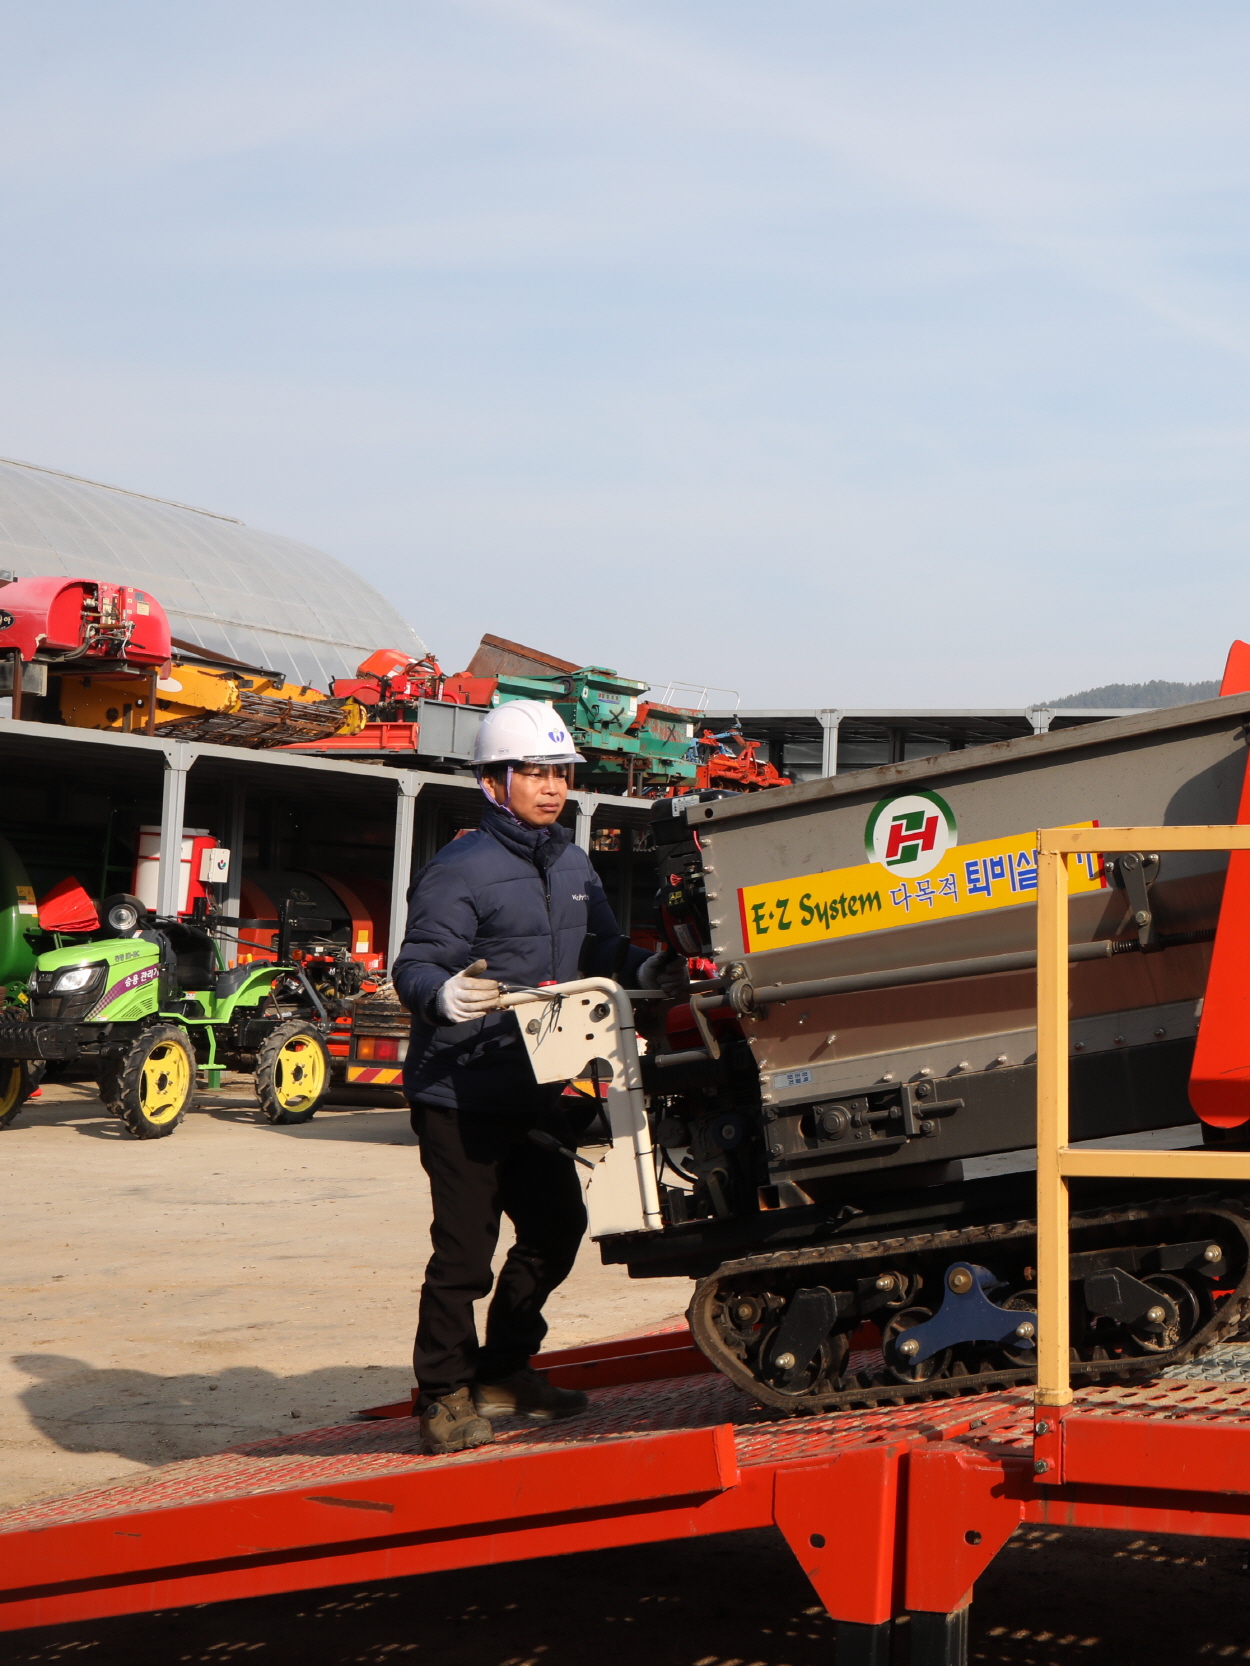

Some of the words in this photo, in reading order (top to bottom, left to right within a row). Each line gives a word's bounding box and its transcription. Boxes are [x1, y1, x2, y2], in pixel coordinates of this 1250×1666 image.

[799, 890, 882, 931] System
[888, 872, 959, 913] 다목적
[124, 974, 139, 987] 승용
